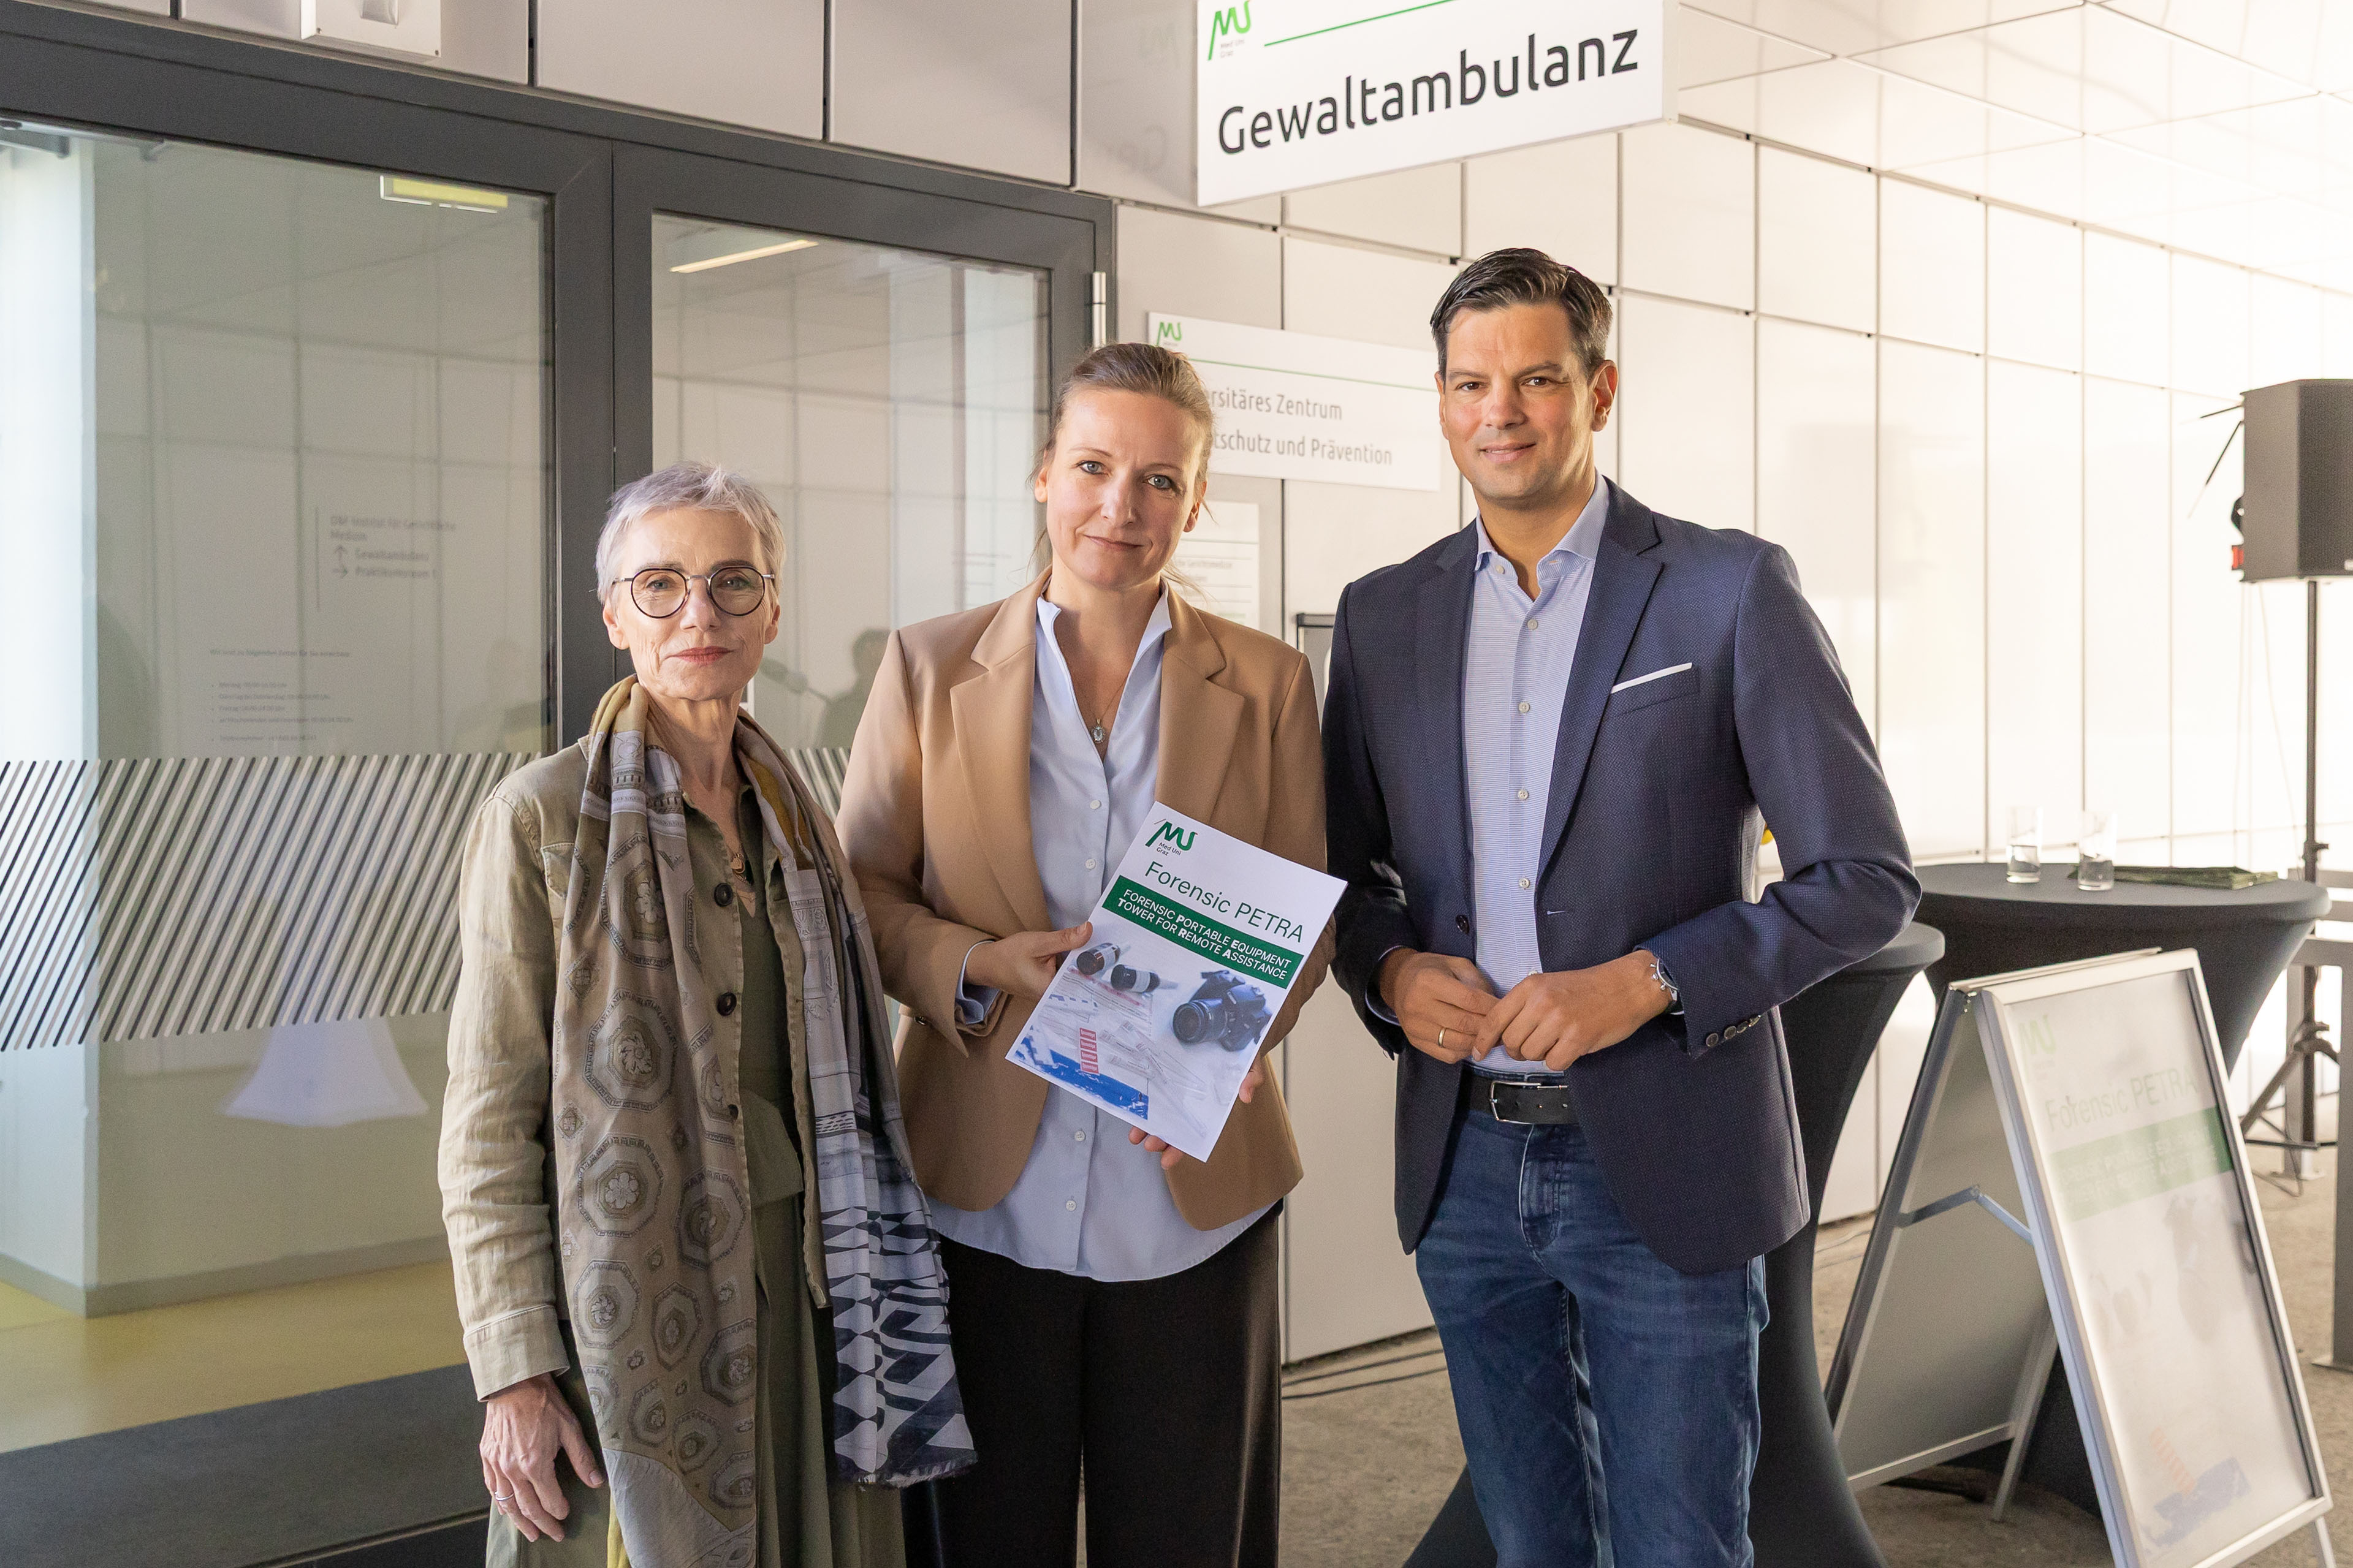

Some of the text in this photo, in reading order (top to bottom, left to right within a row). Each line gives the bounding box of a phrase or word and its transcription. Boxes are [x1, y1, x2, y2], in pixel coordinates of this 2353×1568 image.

[1218, 28, 1639, 155] Gewaltambulanz
[1211, 387, 1343, 421] rsitäres Zentrum
[1214, 428, 1393, 466] tschutz und Prävention
[1156, 847, 1169, 857] Graz
[1158, 842, 1182, 856] Med Uni
[1123, 888, 1292, 969] FORENSIC PORTABLE EQUIPMENT
[1144, 860, 1303, 943] Forensic PETRA
[1117, 897, 1288, 980] TOWER FOR REMOTE ASSISTANCE
[2045, 1064, 2198, 1132] Forensic PETRA
